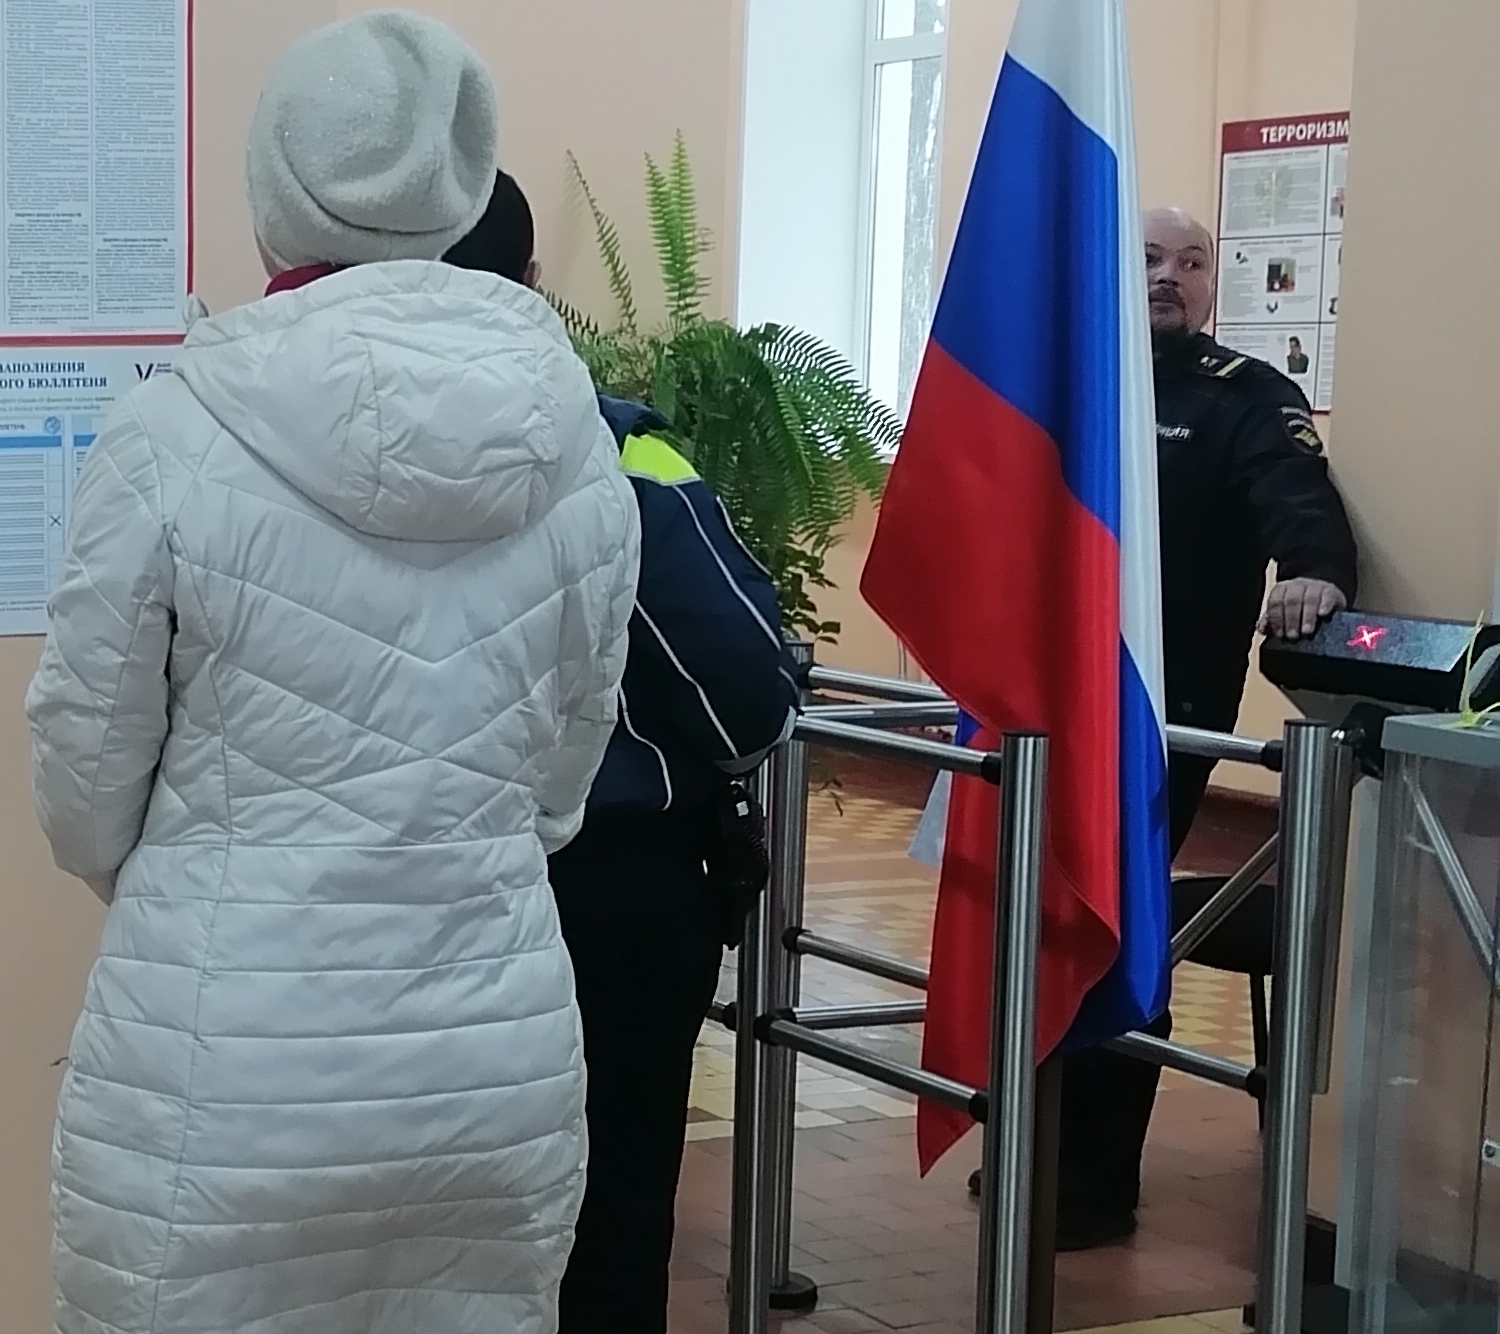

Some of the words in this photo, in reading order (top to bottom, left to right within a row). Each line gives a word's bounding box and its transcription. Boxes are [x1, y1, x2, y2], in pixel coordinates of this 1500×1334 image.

[1260, 118, 1350, 144] ТЕРРОРИЗМ
[28, 377, 108, 389] БЮЛЛЕТЕНЯ
[1156, 424, 1190, 440] ИЦИЯ
